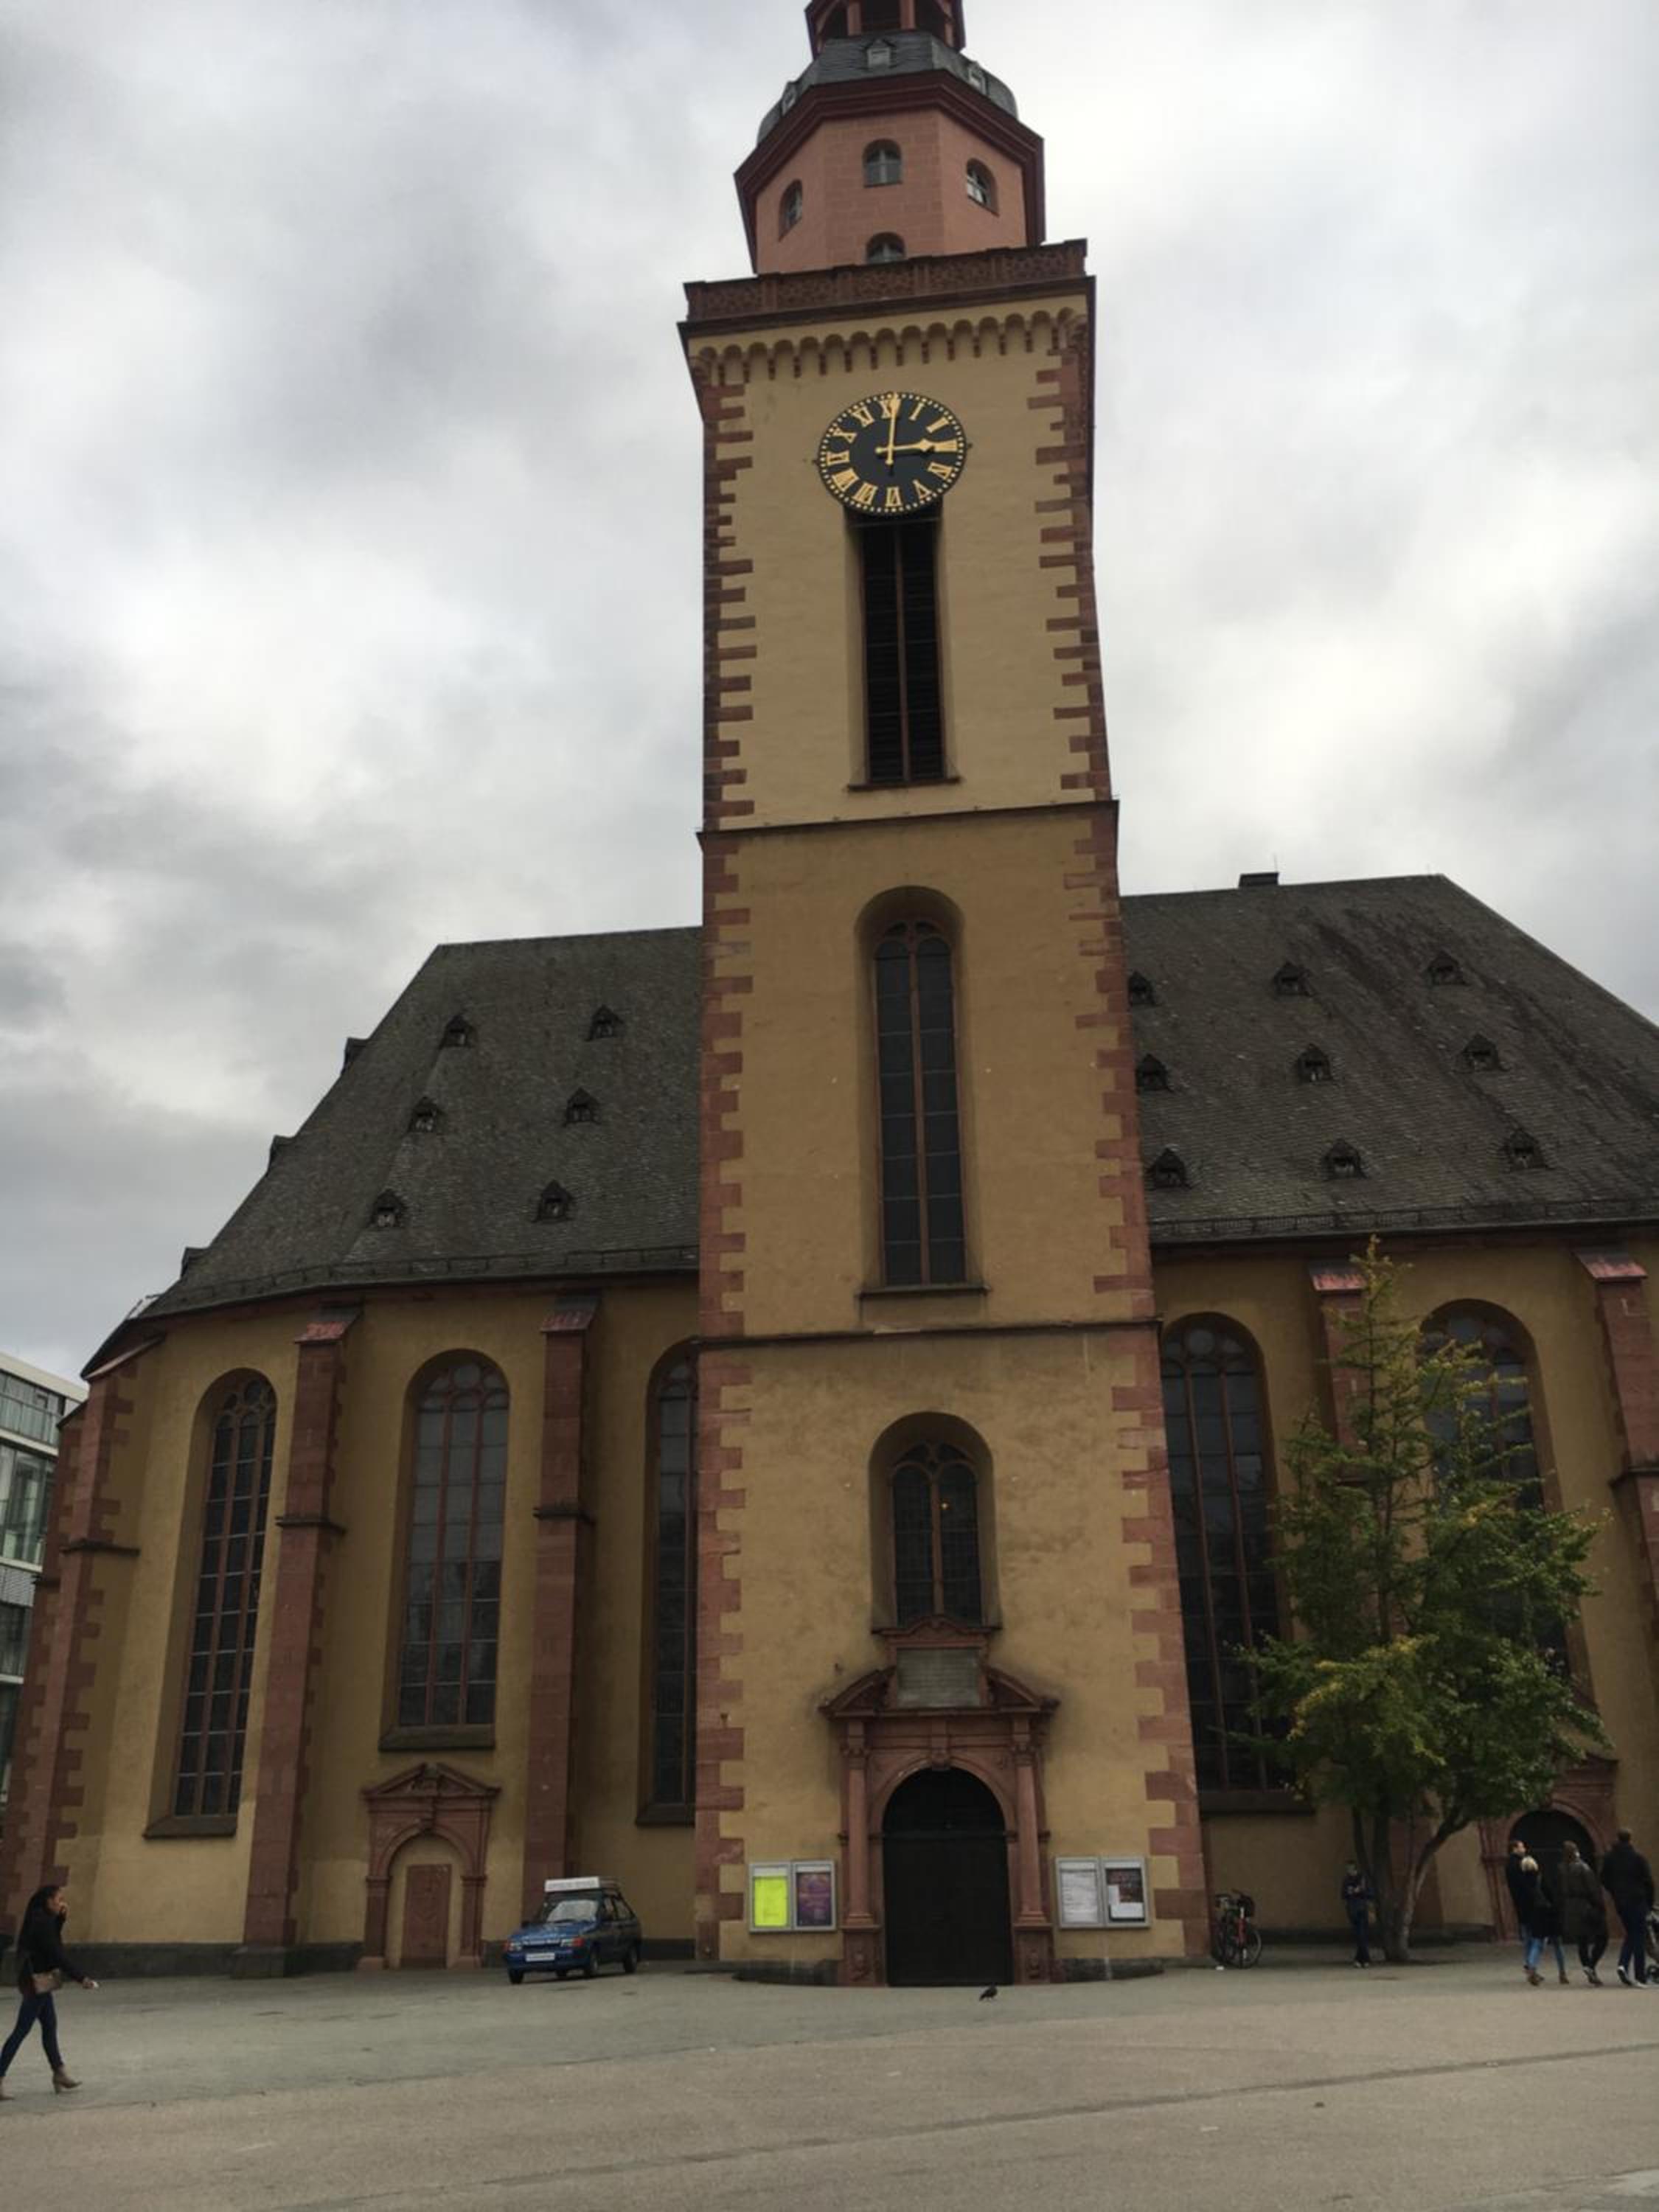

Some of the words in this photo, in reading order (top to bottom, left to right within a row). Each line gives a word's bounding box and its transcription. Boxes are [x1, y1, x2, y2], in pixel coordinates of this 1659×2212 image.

[851, 406, 874, 427] XI
[908, 403, 924, 420] I
[833, 427, 857, 443] X
[886, 487, 902, 507] VI
[913, 479, 931, 501] V
